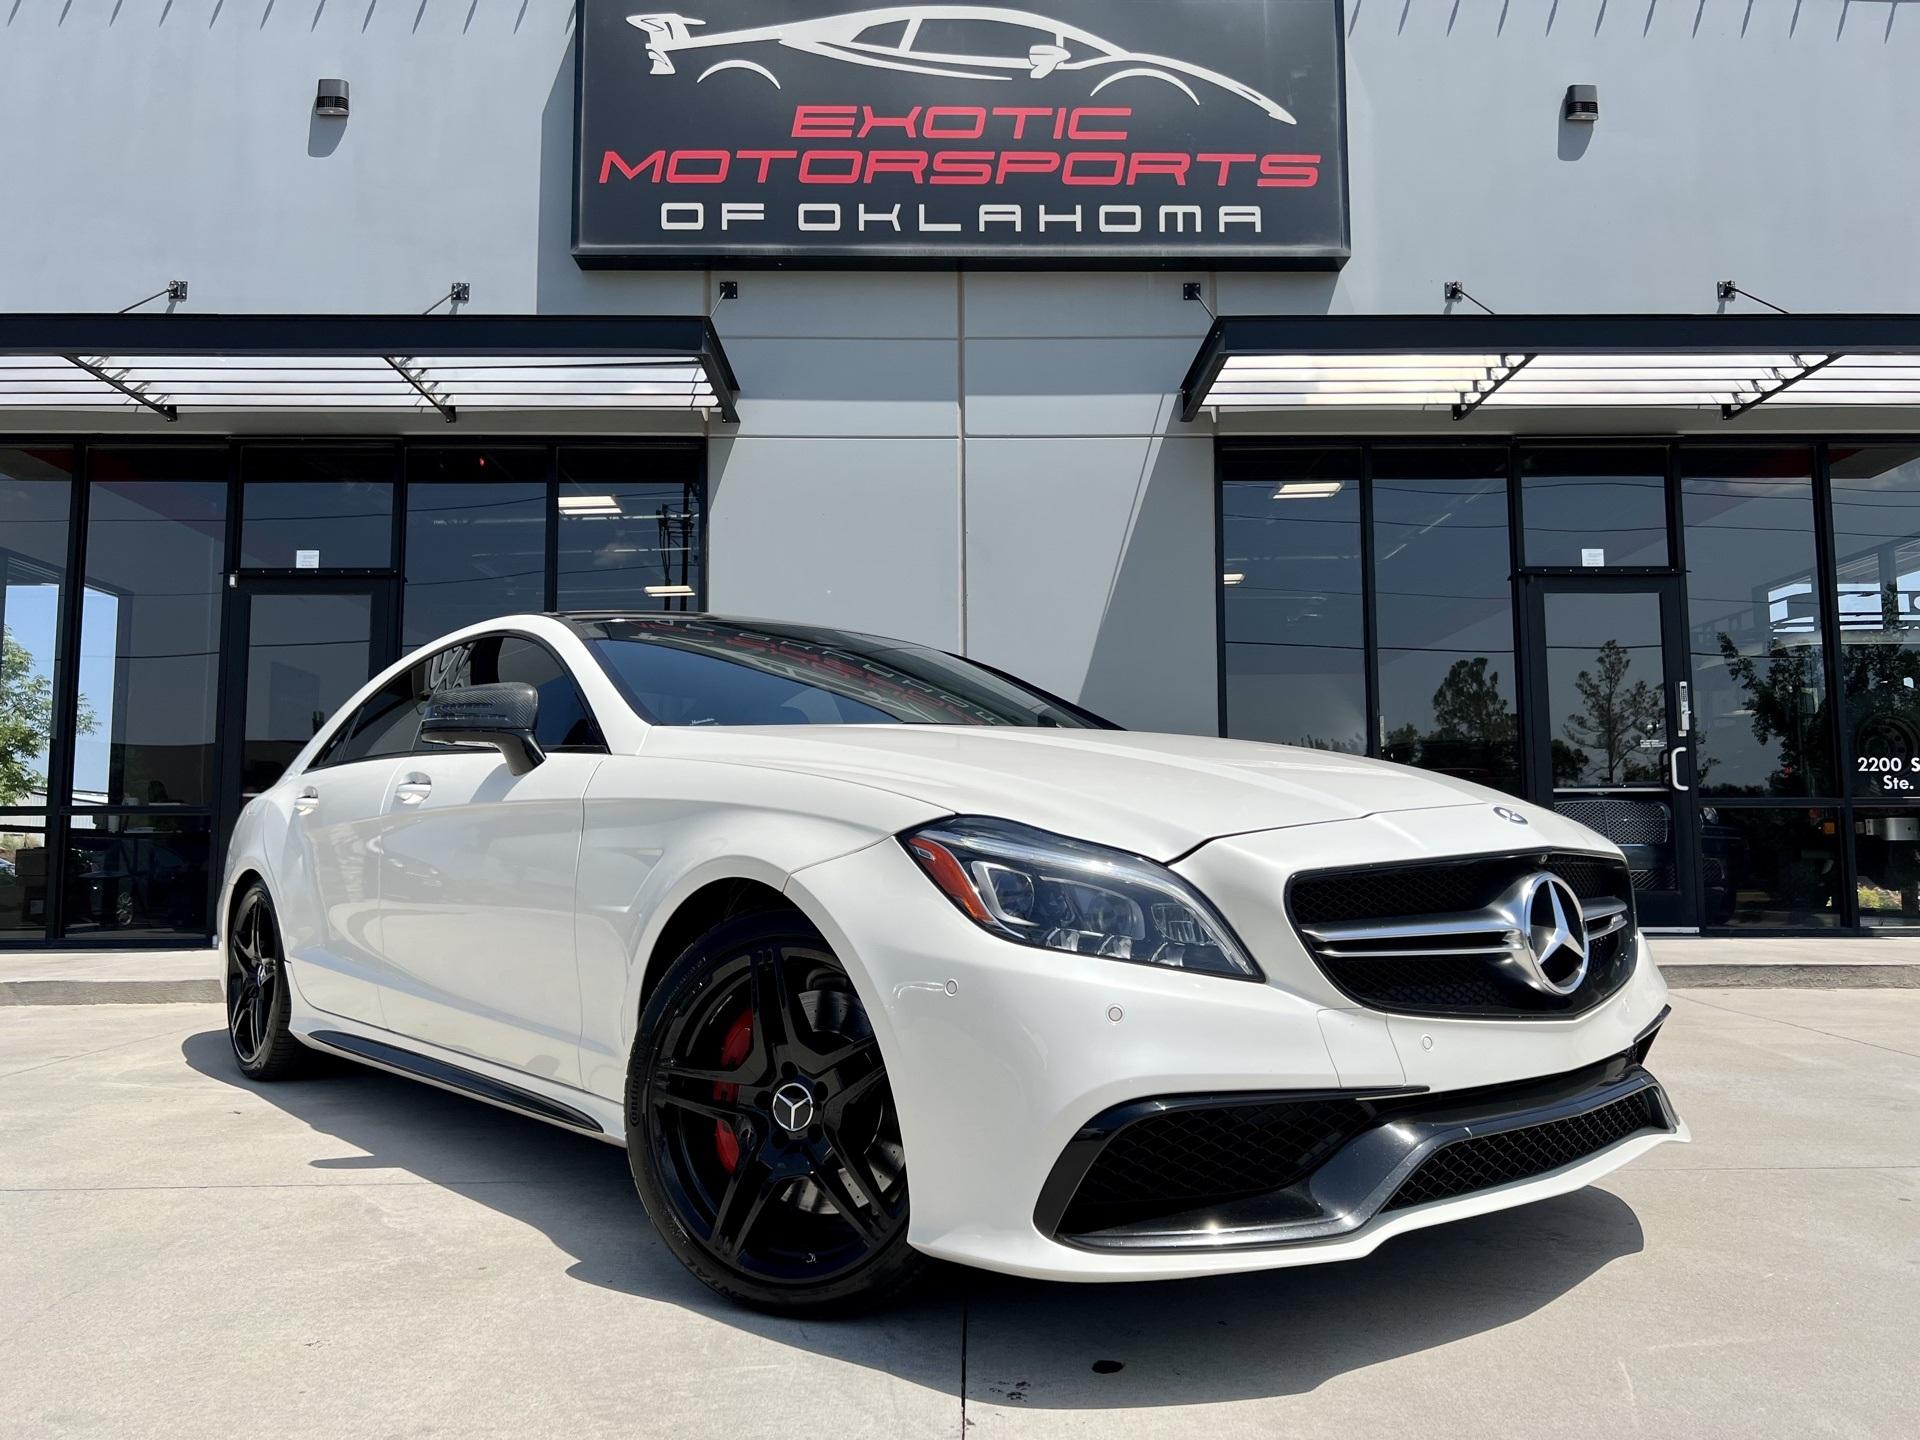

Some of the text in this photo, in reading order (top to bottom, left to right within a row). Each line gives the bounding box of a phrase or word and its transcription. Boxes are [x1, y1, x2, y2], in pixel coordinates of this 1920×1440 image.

[791, 104, 1132, 141] EXOTIC
[599, 149, 1321, 188] MOTORSPORTS
[660, 202, 1263, 233] OF OKLAHOMA
[1857, 756, 1902, 773] 2200
[1882, 774, 1915, 790] Ste.
